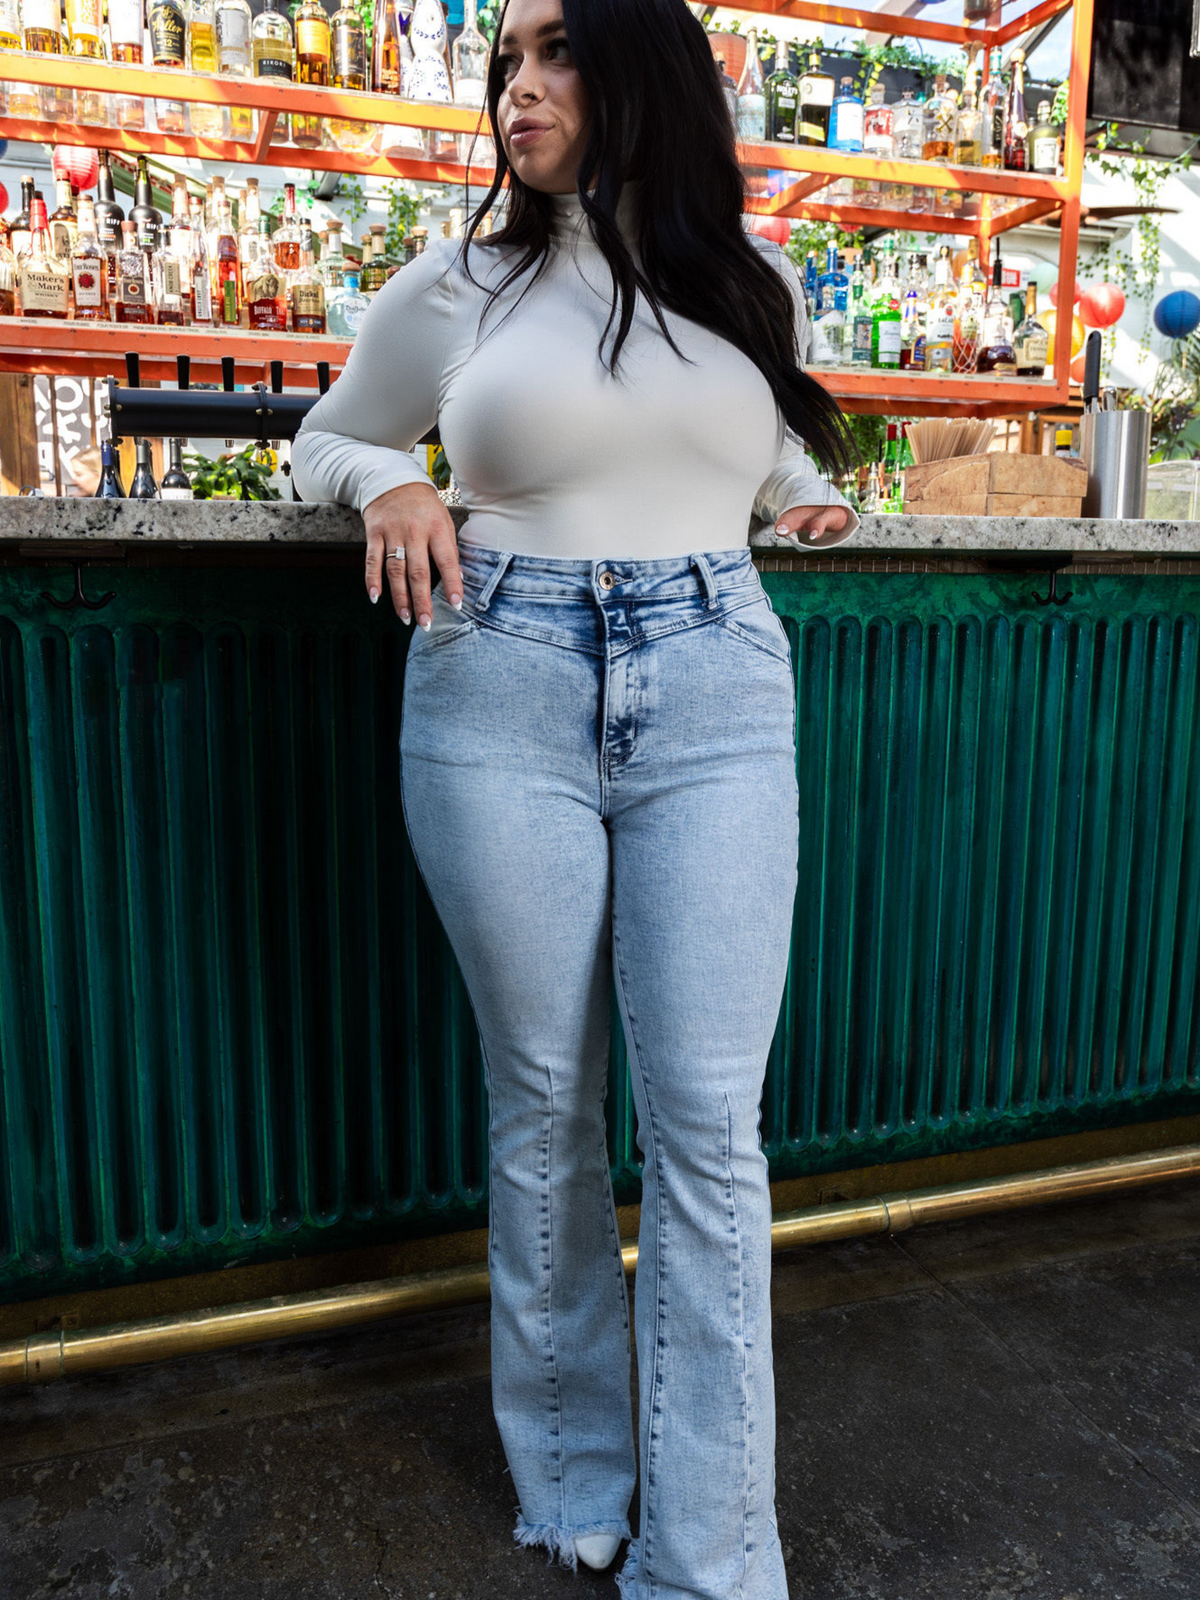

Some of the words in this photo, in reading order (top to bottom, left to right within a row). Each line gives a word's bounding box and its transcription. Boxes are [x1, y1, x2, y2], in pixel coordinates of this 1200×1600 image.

[152, 18, 182, 34] Wller
[27, 274, 65, 284] Maker's
[38, 282, 65, 292] Mark
